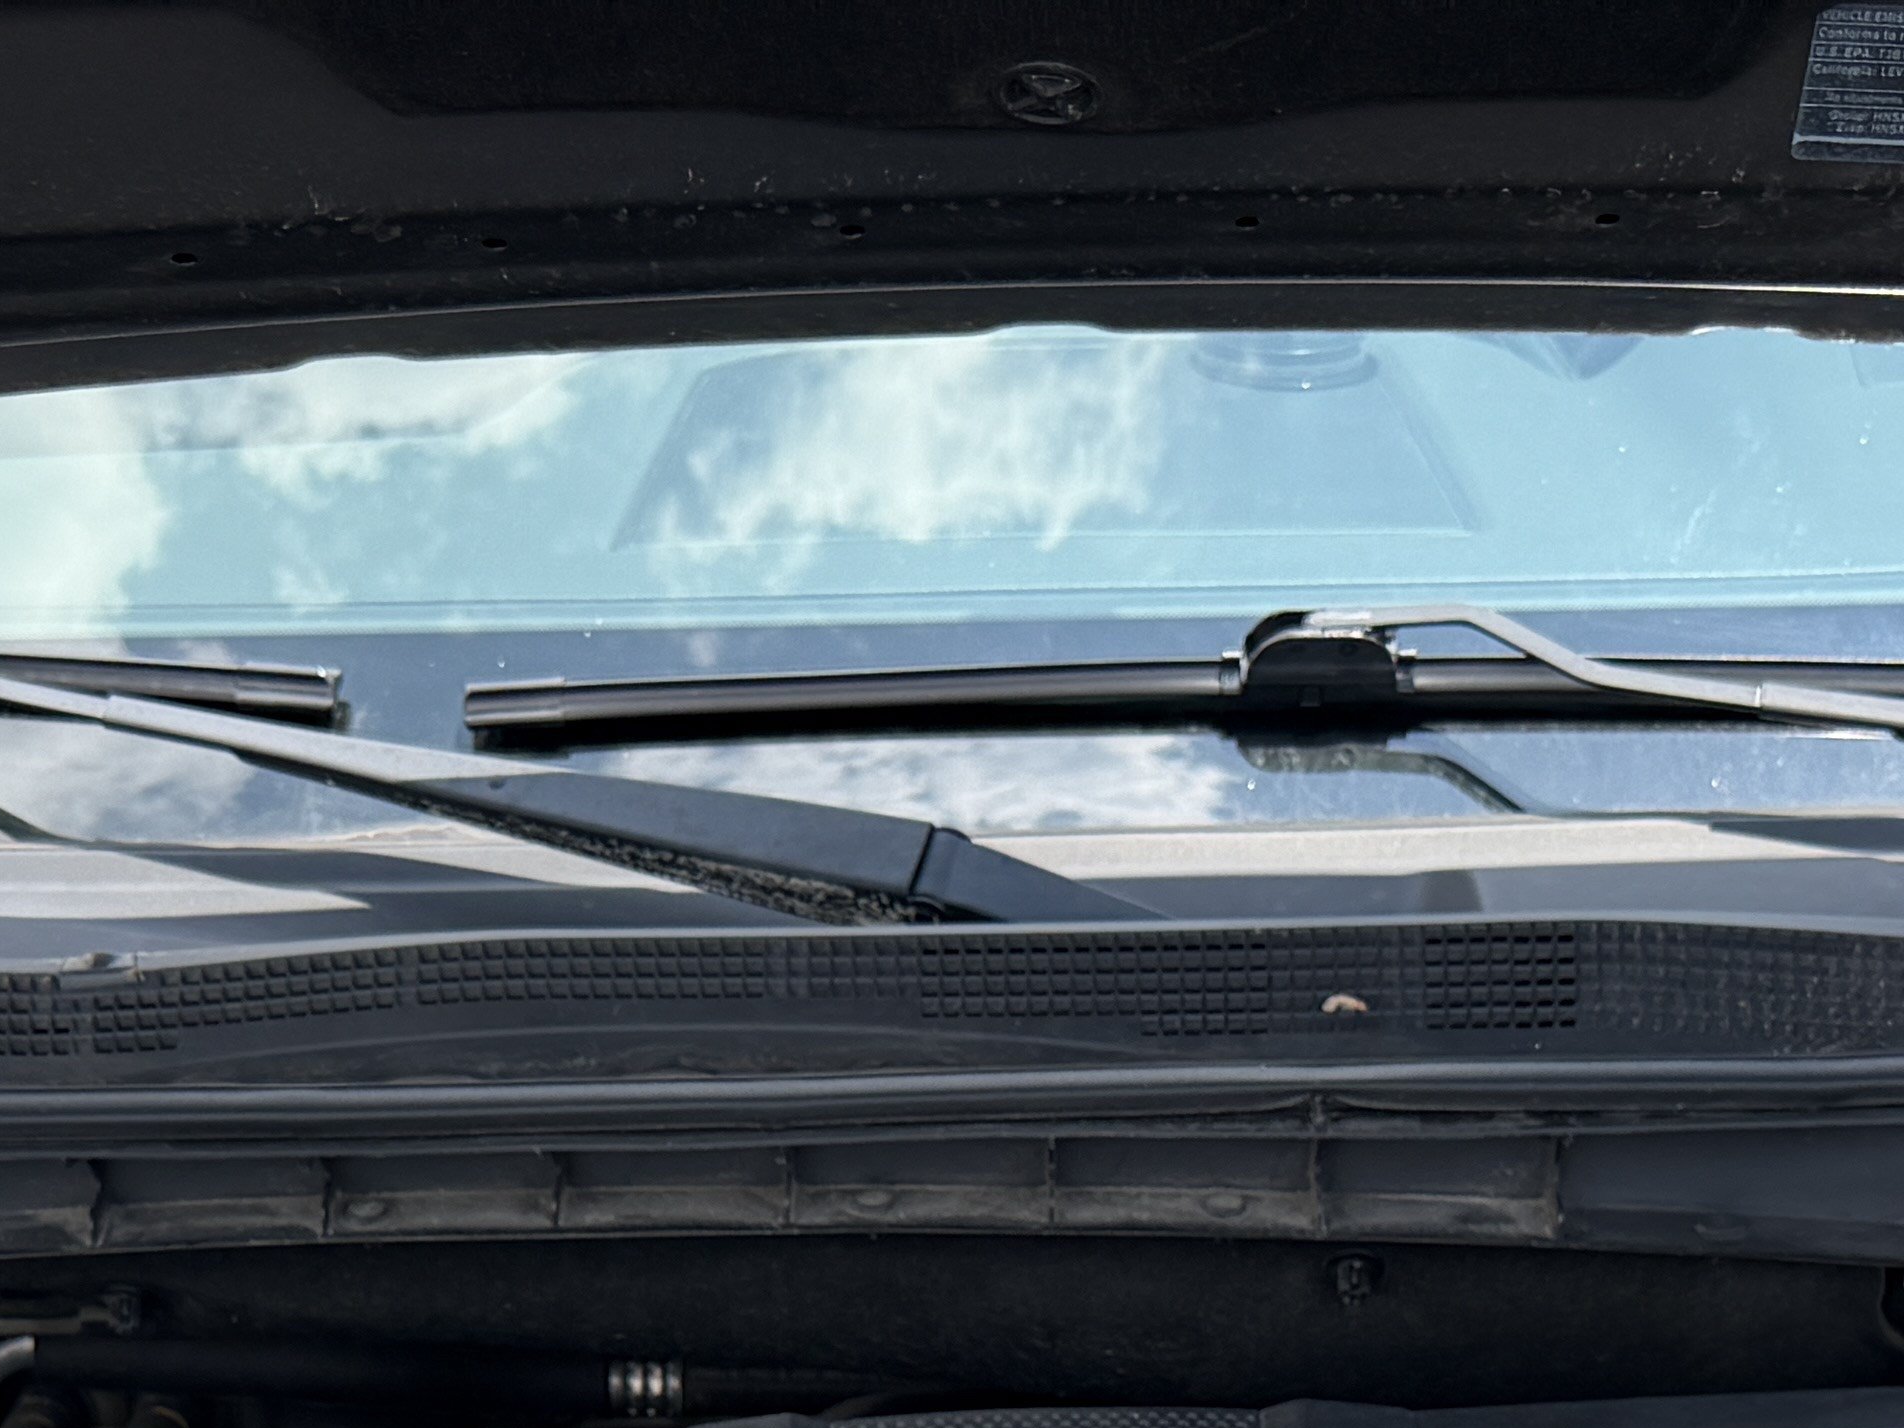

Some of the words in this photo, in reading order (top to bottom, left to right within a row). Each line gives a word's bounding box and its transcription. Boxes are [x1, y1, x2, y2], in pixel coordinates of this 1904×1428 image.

[1822, 10, 1872, 22] VEHICLE
[1818, 26, 1880, 40] Conforms
[1882, 30, 1896, 41] to
